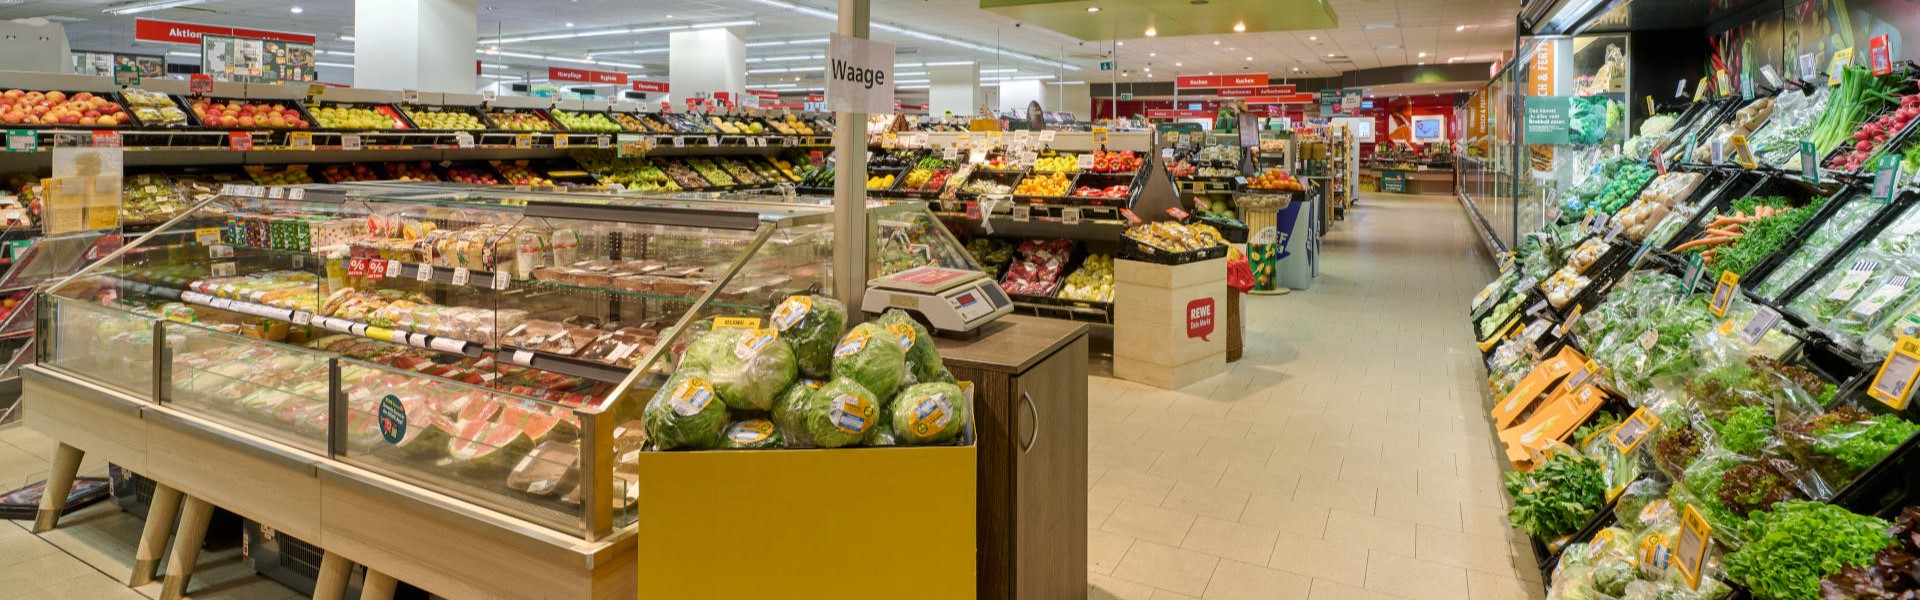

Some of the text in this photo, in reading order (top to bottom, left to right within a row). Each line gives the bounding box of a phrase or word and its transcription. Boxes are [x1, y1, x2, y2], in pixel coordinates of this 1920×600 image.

[169, 28, 202, 39] Aktion
[831, 58, 885, 90] Waage
[1235, 77, 1254, 85] Kuchen
[1191, 304, 1210, 320] REWE
[1190, 318, 1210, 330] Dein Markt
